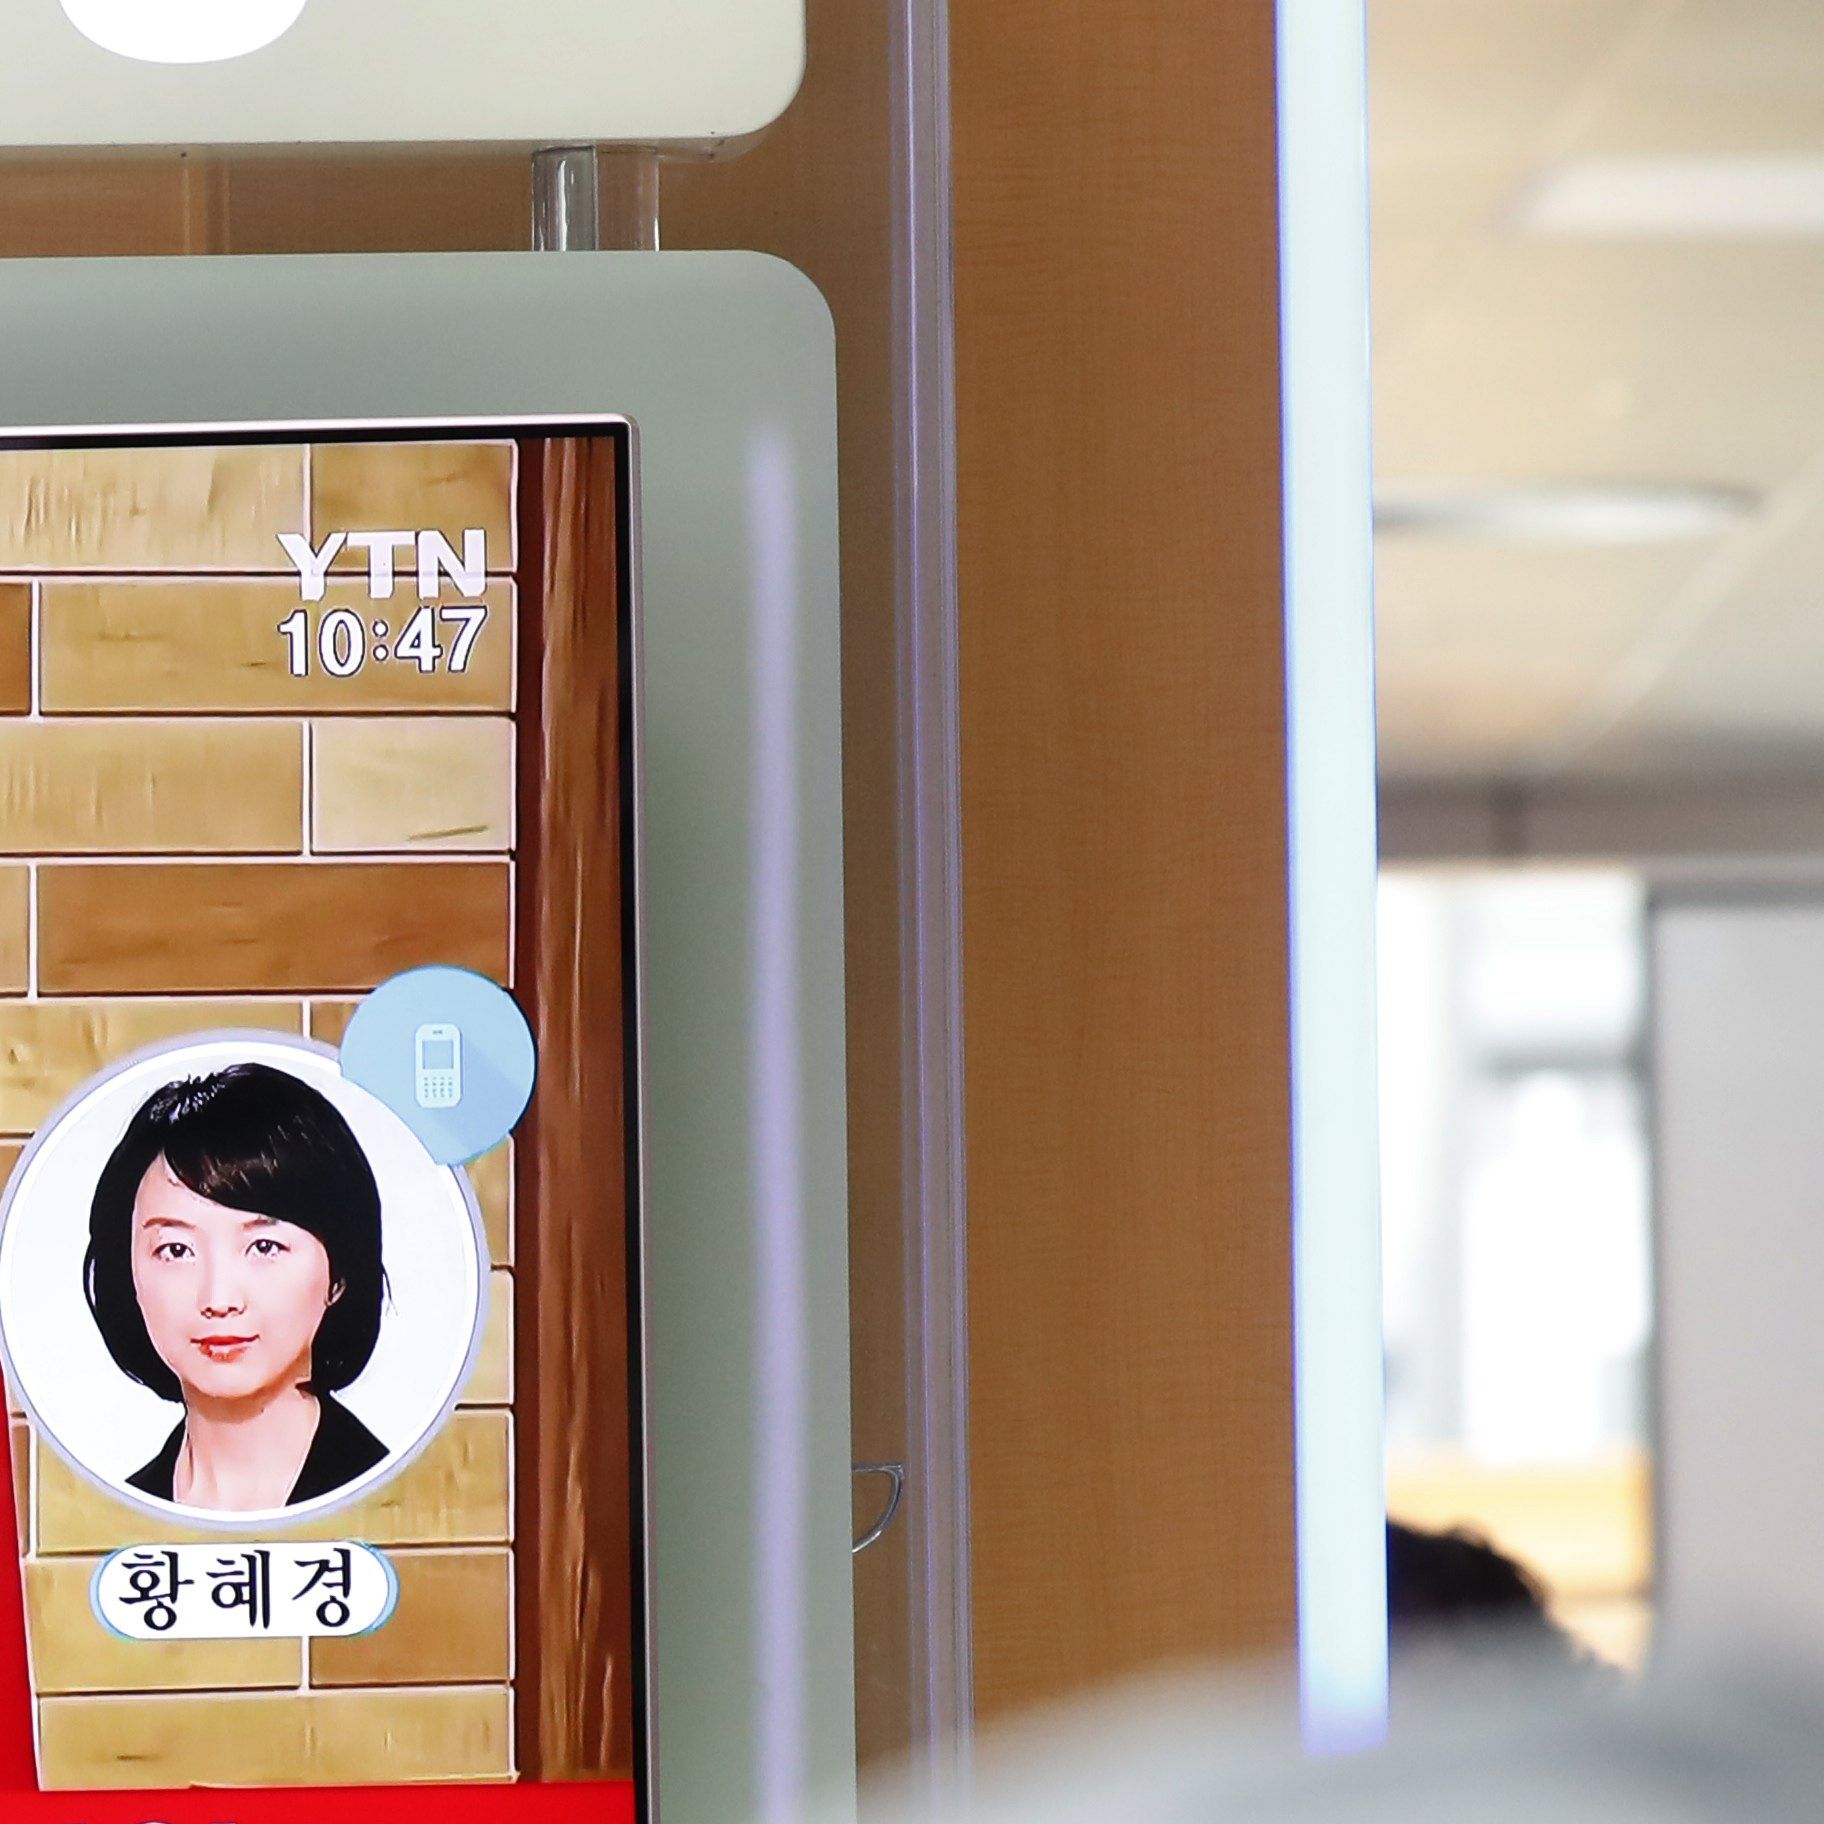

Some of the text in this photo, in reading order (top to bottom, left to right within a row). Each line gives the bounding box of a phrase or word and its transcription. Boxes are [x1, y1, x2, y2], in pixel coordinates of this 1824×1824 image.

[278, 529, 487, 601] YTN
[278, 606, 488, 677] 10:47
[118, 1549, 352, 1631] 황혜경
